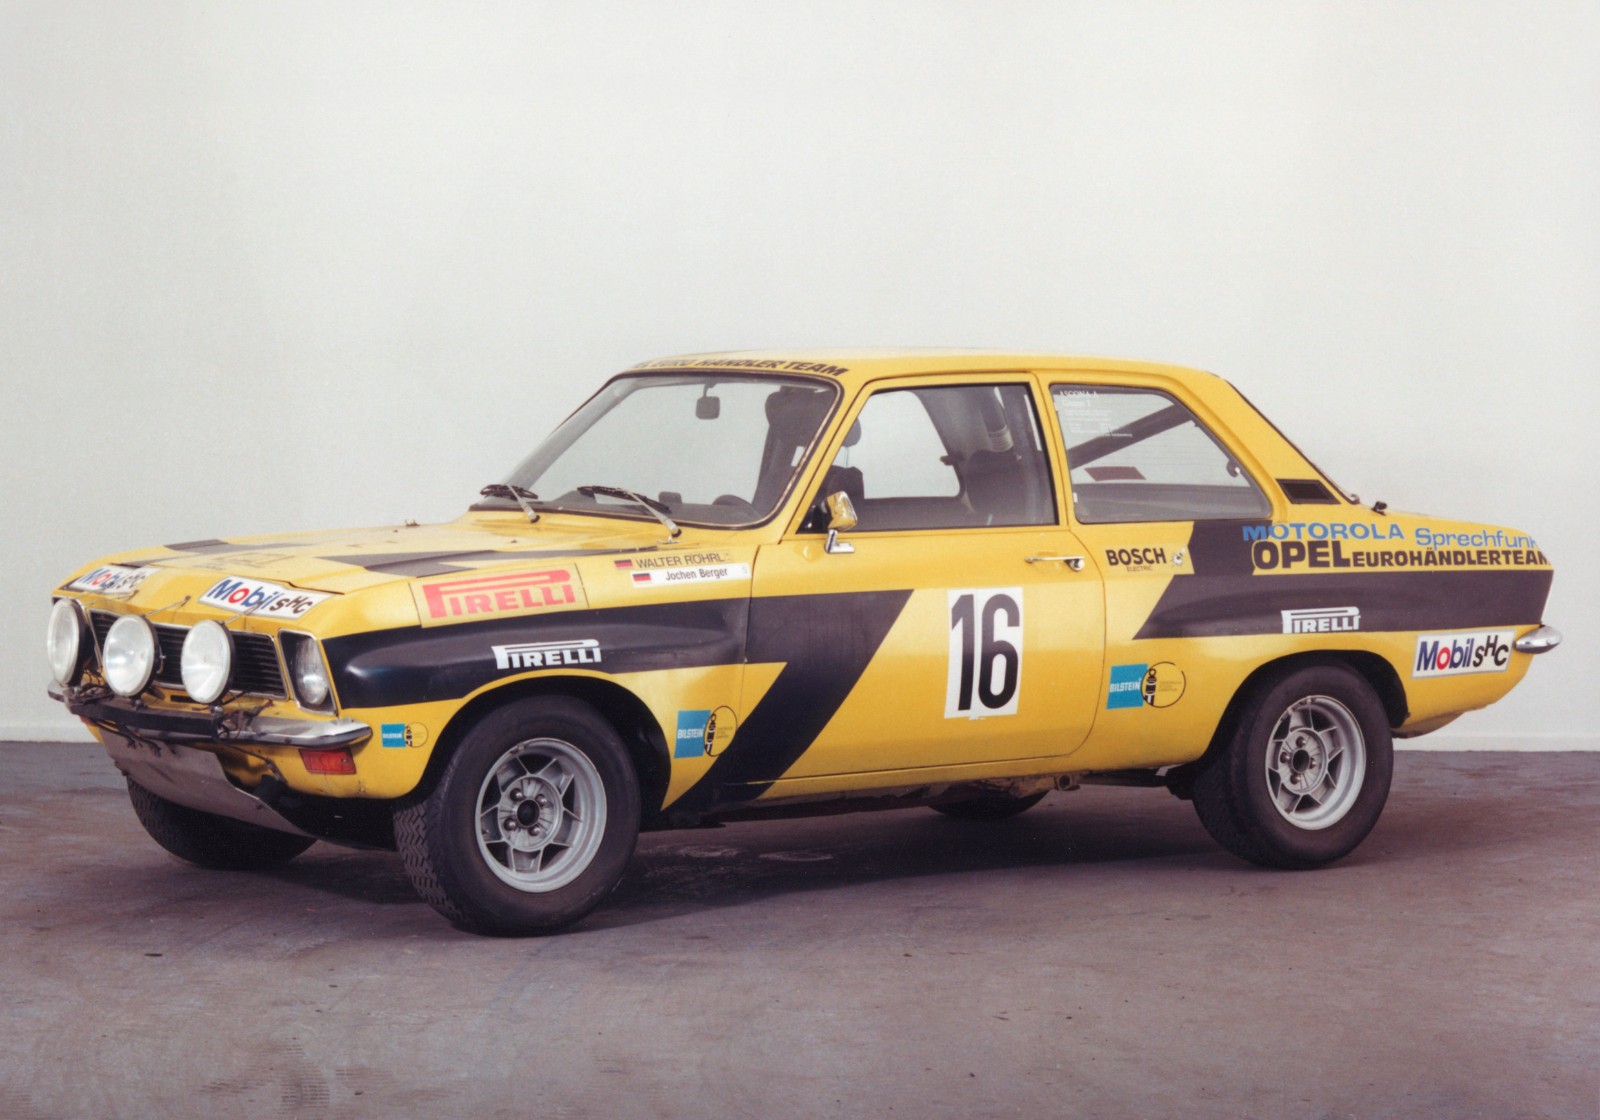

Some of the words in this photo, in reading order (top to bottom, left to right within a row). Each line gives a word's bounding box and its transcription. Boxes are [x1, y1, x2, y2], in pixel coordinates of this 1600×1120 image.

[783, 361, 849, 376] TEAM
[1242, 522, 1404, 541] MOTOROLA
[636, 557, 681, 569] WALTER
[1105, 547, 1167, 566] BOSCH
[1253, 540, 1351, 569] OPEL
[665, 570, 697, 581] Jochen
[698, 567, 728, 579] Berger
[207, 579, 276, 611] Mobil
[269, 595, 314, 614] SHC
[422, 569, 576, 619] PIRELLI
[1281, 606, 1361, 634] PIRELLI
[491, 639, 602, 670] PIRELLI
[951, 593, 1020, 711] 16
[1416, 638, 1473, 672] Mobil
[1472, 634, 1509, 668] SHC
[1109, 681, 1141, 693] BILSTEIN
[677, 727, 704, 739] BILSTEIN
